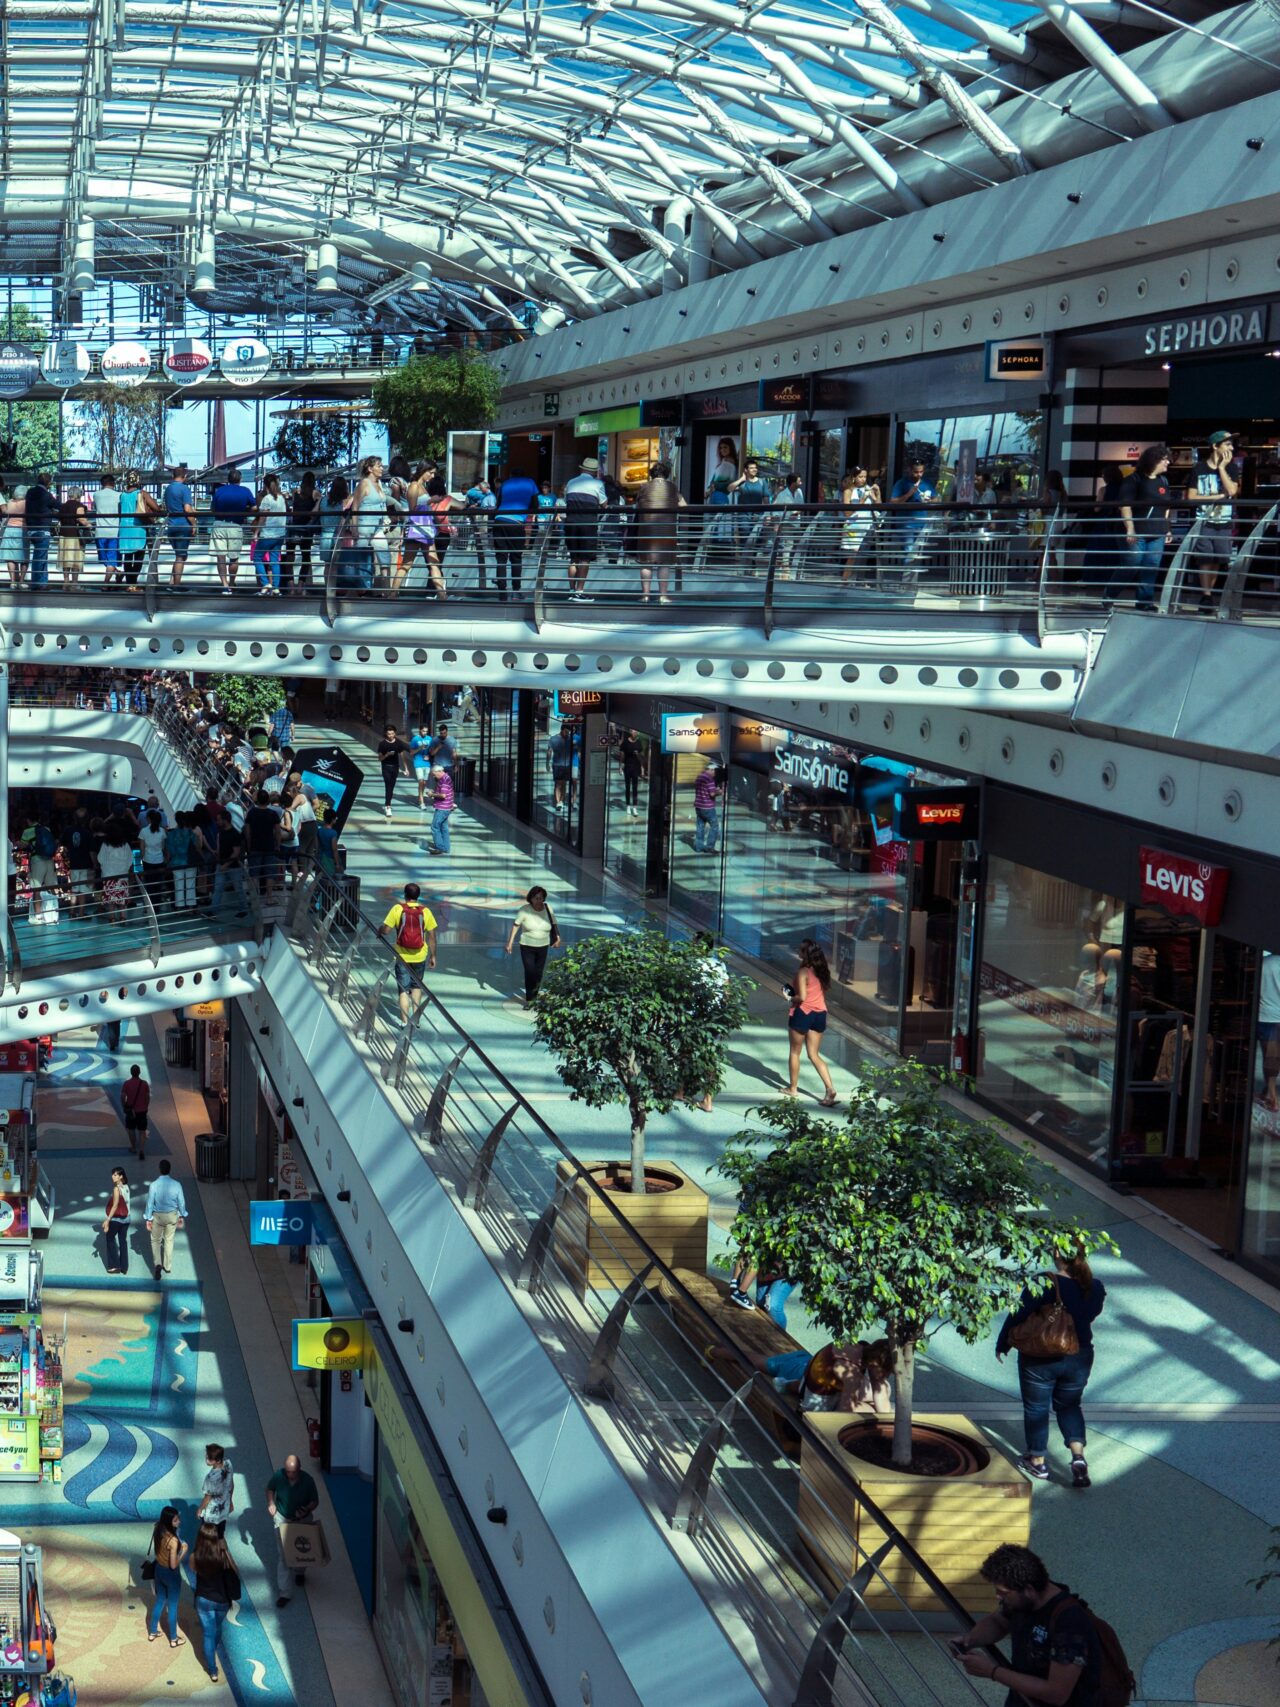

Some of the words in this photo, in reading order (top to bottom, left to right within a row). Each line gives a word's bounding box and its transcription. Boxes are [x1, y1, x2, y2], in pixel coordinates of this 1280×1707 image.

[1144, 310, 1263, 355] SEPHORA
[103, 359, 150, 370] Chopperia
[168, 358, 208, 367] LUSITANA
[572, 691, 601, 703] GILLES
[669, 728, 720, 737] Samsonite
[774, 745, 848, 793] Samsonite
[260, 1217, 304, 1231] MEO
[315, 1356, 357, 1366] CELEIRO
